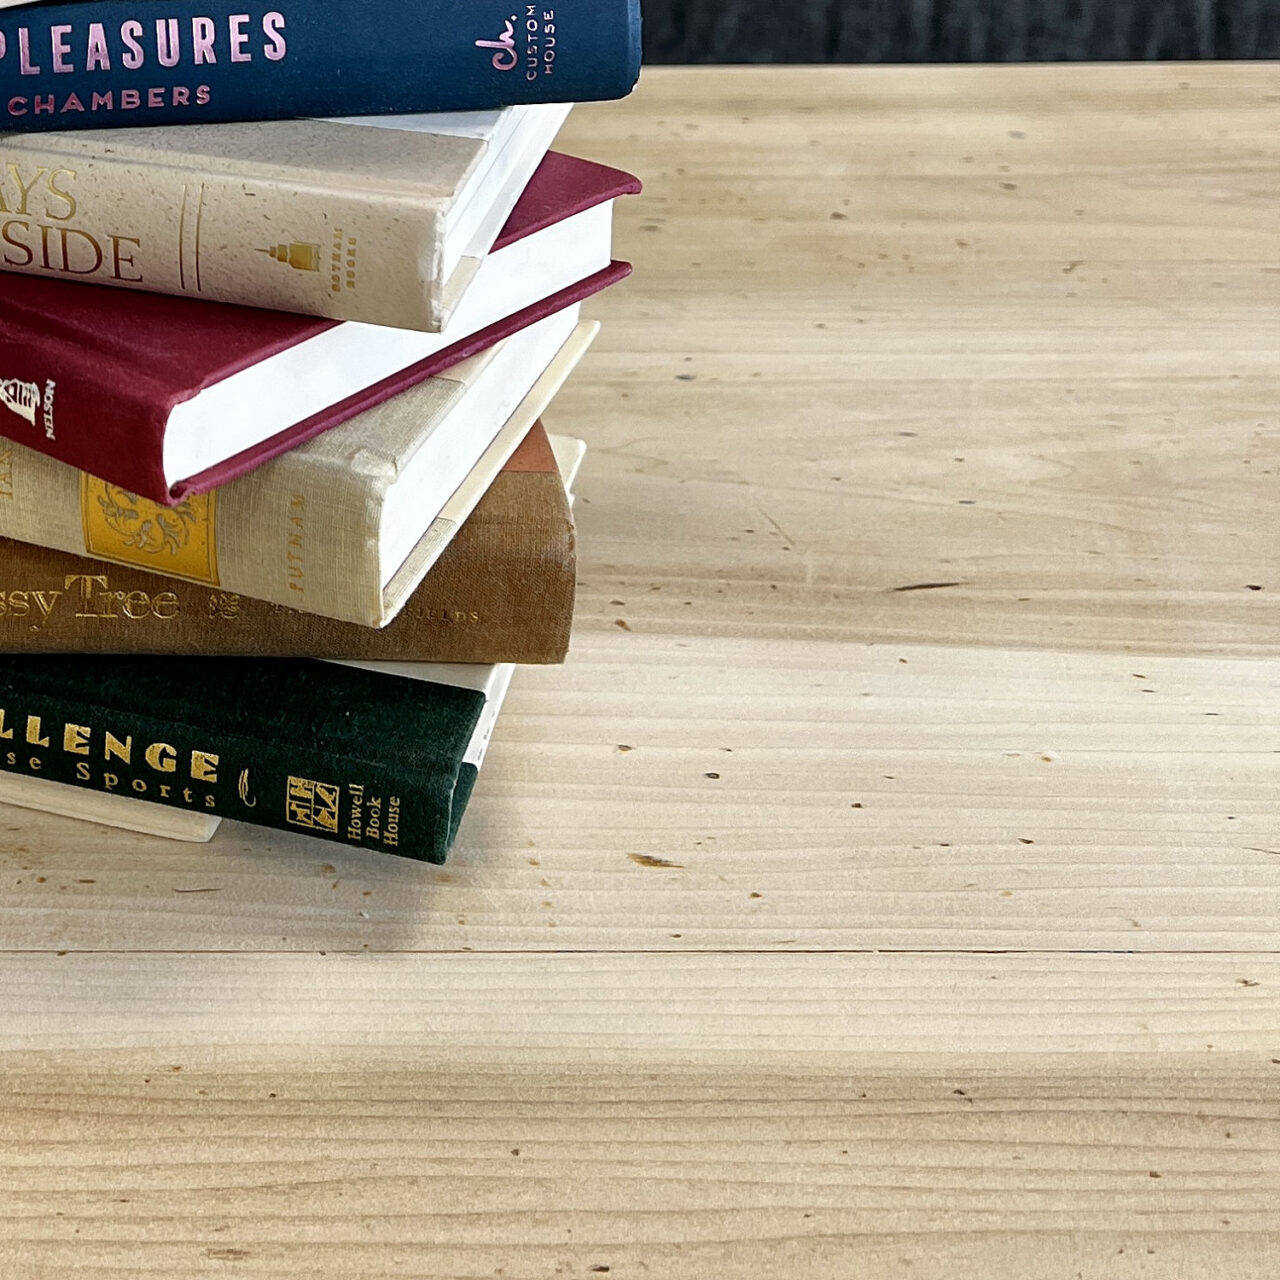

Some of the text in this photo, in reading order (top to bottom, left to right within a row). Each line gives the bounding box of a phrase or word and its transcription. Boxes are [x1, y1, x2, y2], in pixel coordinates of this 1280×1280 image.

[526, 4, 539, 81] CUSTOM
[543, 9, 556, 74] HOUSE
[7, 84, 211, 117] CHAMBERS
[1, 219, 144, 283] SIDE
[43, 378, 56, 440] NELSON
[287, 495, 305, 593] PUTNAM
[63, 574, 180, 620] Tree
[75, 762, 216, 809] Sports
[346, 783, 365, 842] Howell
[365, 795, 382, 840] Book
[383, 795, 401, 848] House
